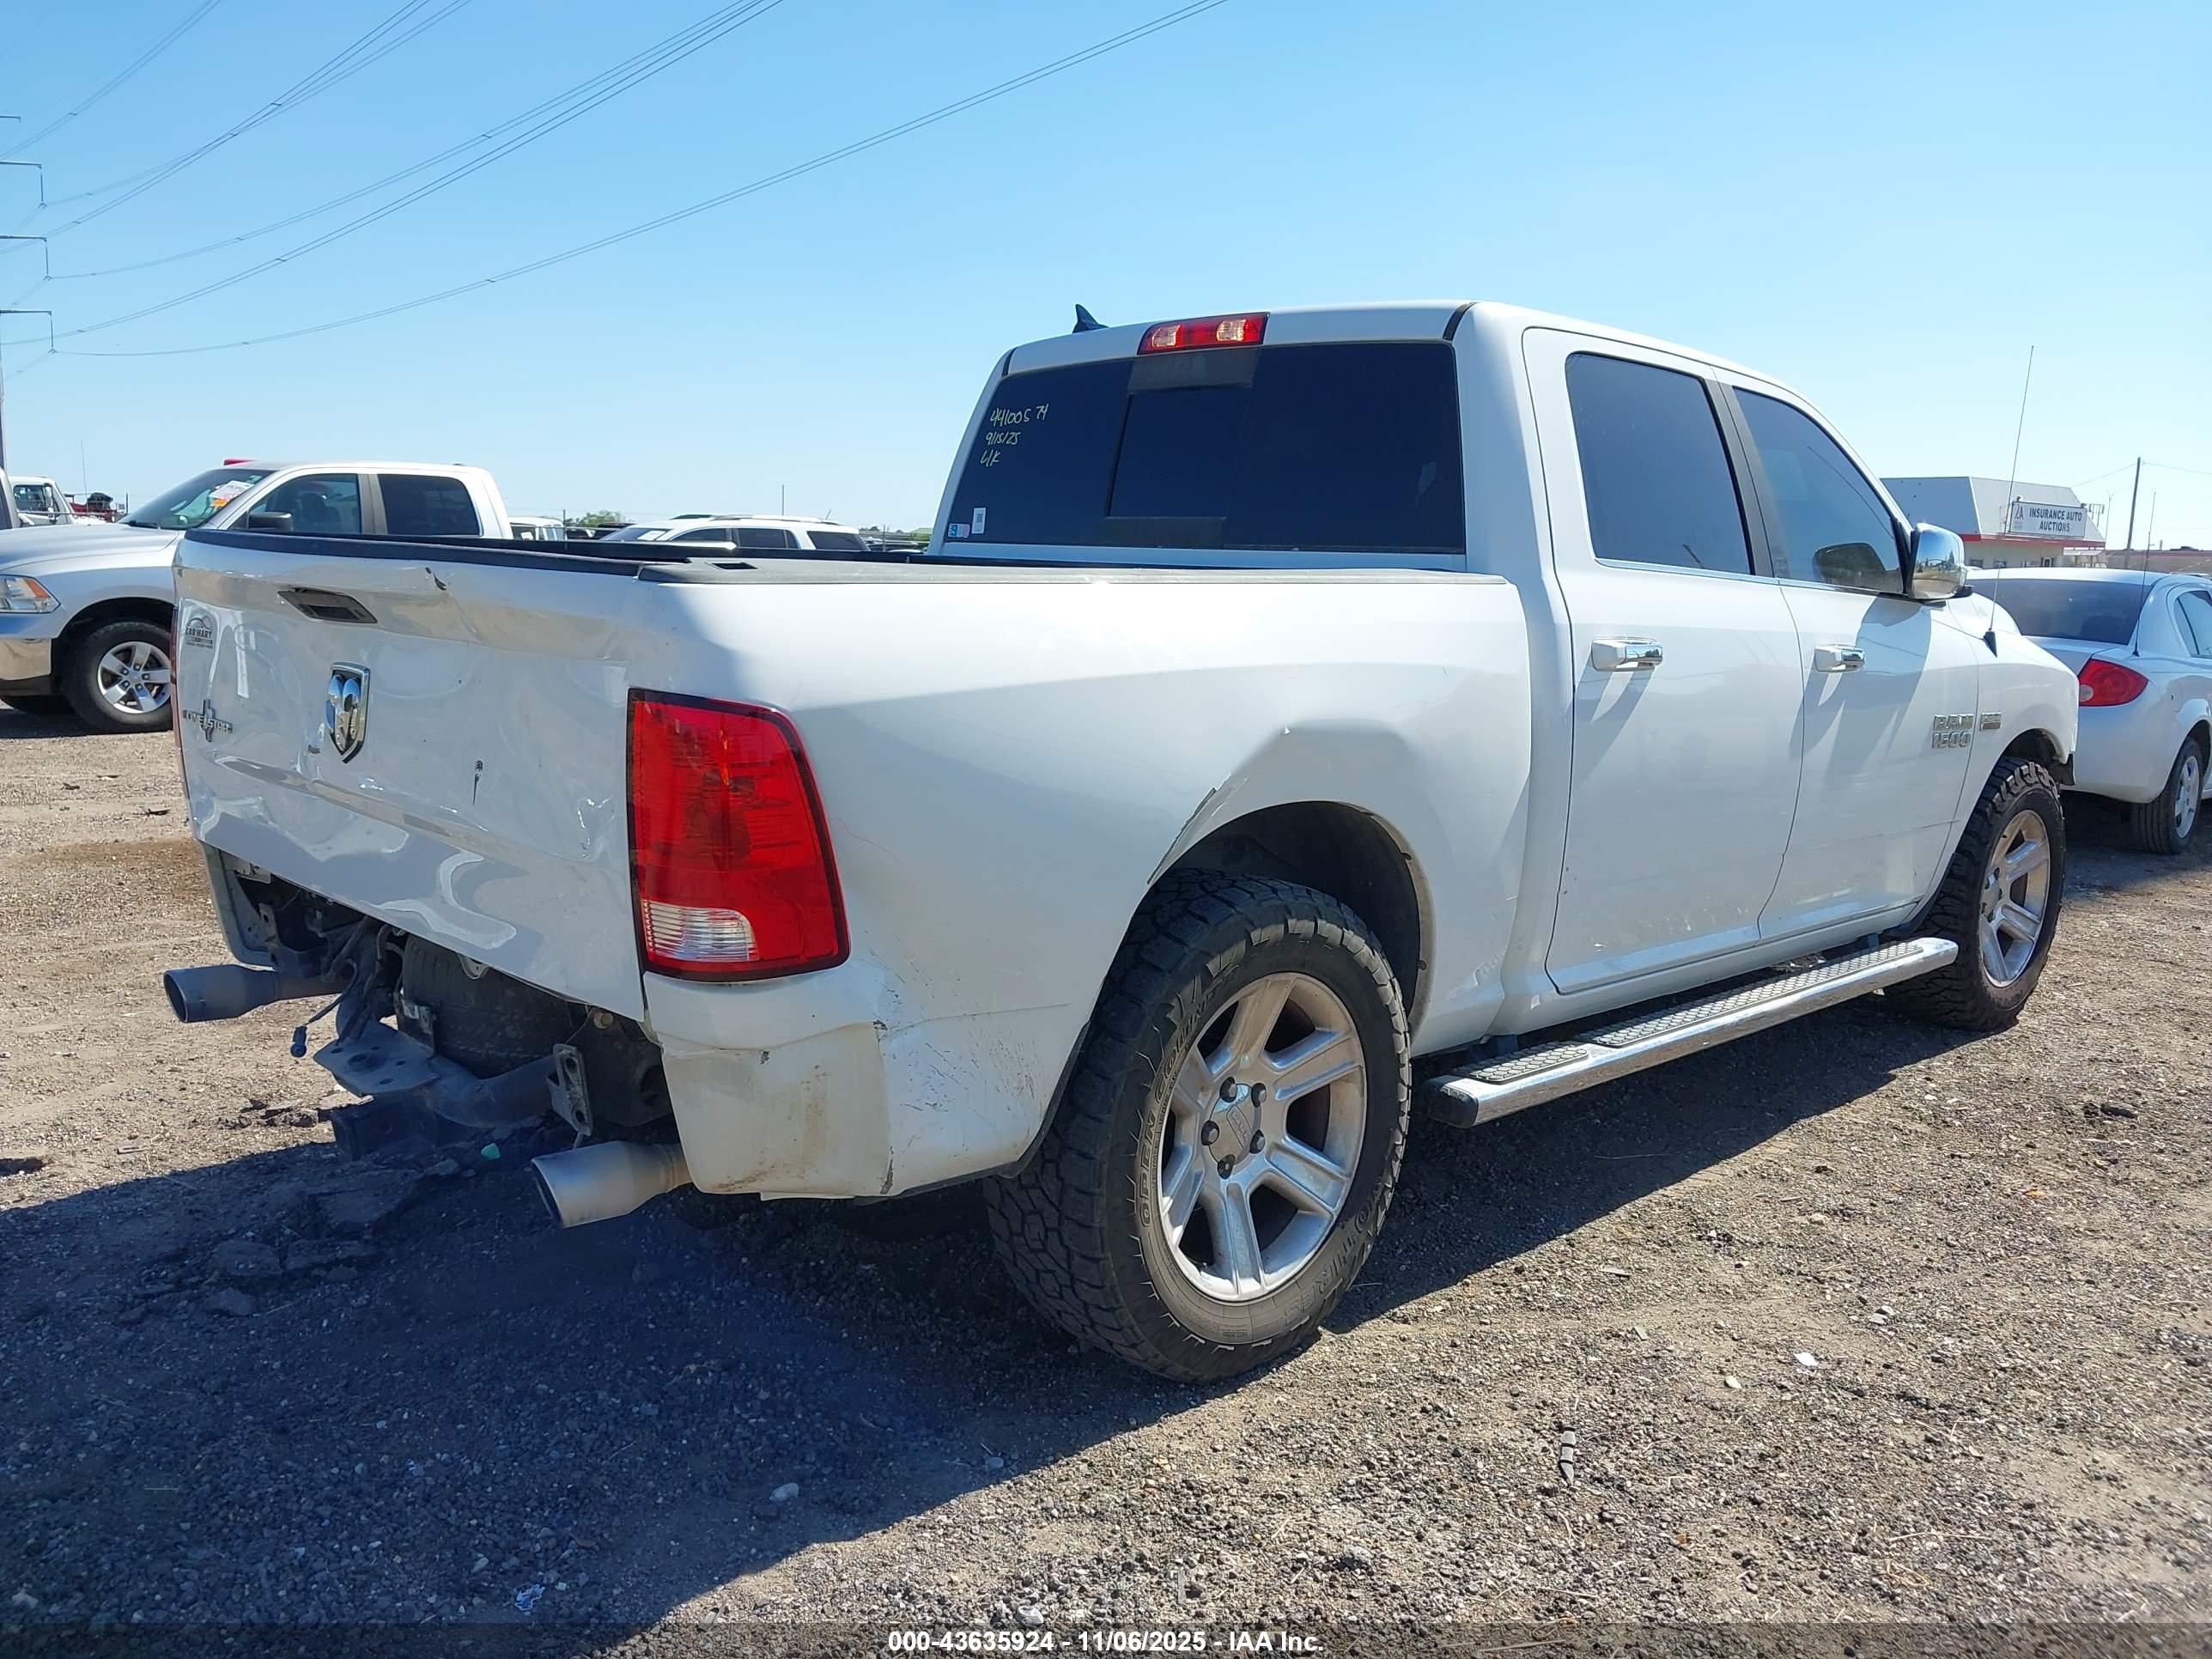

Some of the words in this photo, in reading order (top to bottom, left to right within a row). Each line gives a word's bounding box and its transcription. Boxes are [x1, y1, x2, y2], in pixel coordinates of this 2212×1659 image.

[2029, 507, 2065, 520] INSURANCE
[2066, 511, 2082, 522] AUTO
[2039, 520, 2070, 532] AUCTIONS
[1933, 714, 1974, 731] RAM
[1931, 731, 1972, 750] 1500
